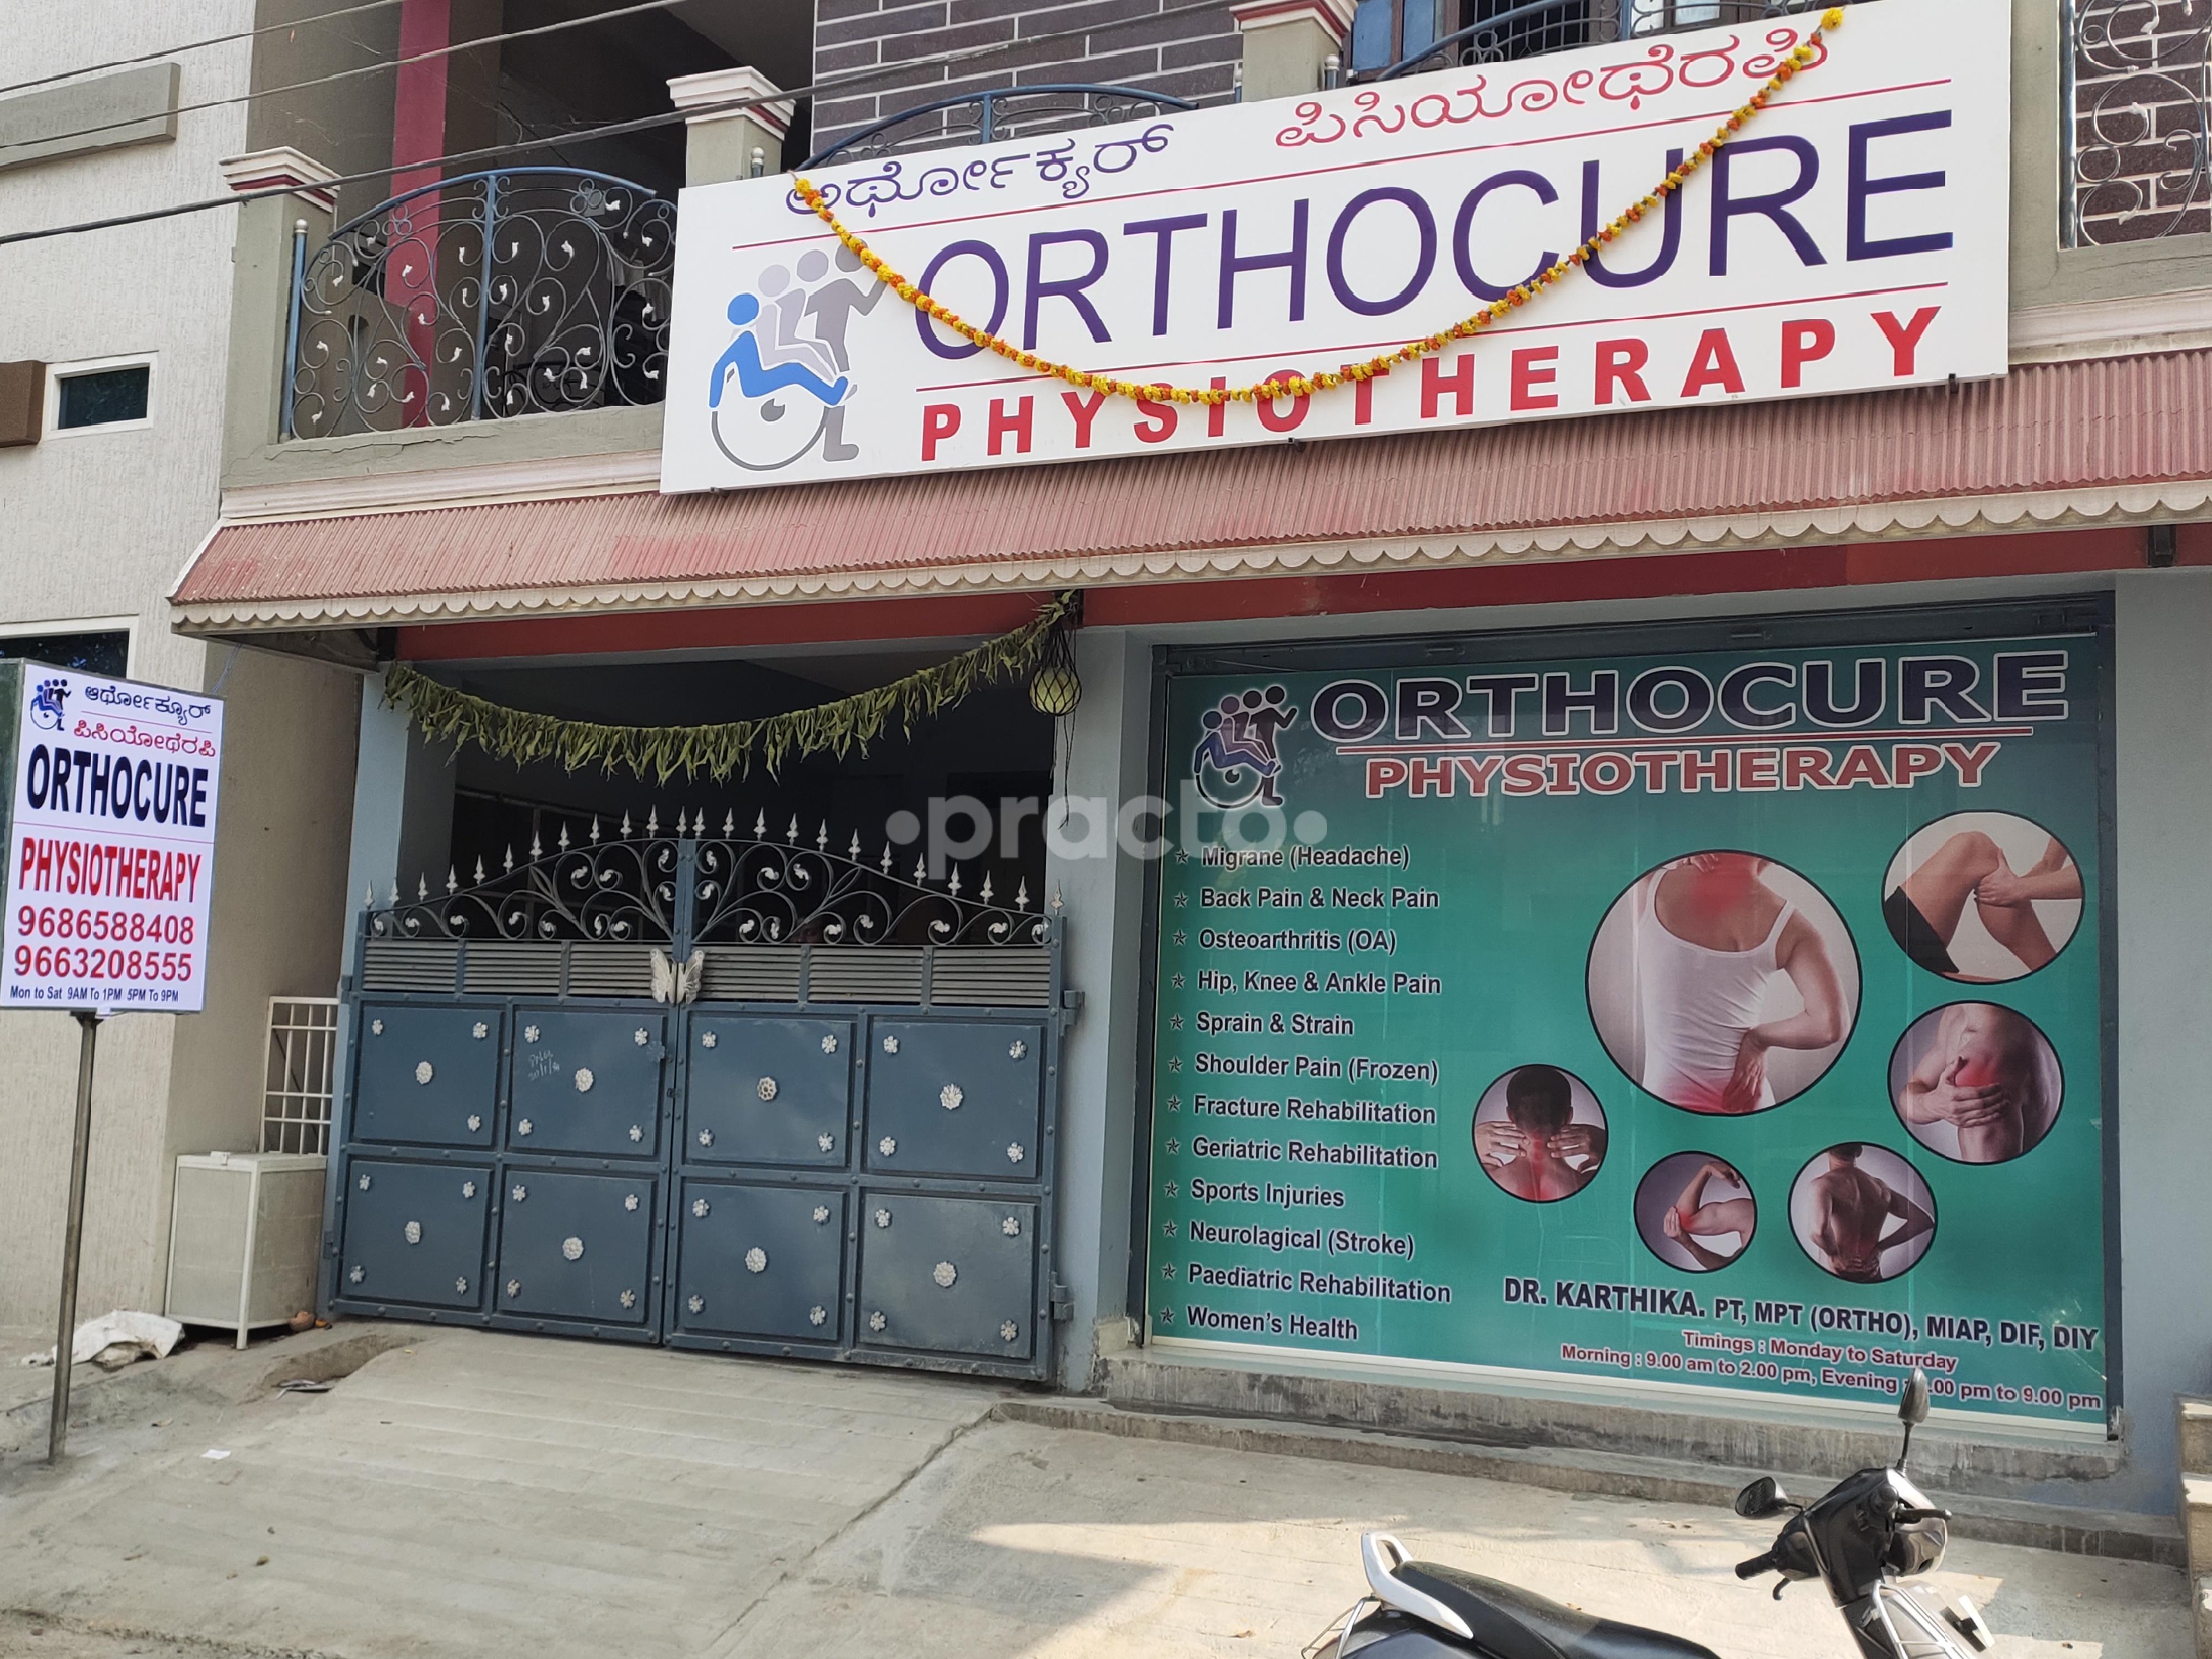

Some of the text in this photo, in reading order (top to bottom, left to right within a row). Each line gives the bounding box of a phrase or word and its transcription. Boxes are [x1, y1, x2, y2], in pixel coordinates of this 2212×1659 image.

[915, 110, 1953, 359] ORTHOCURE
[921, 305, 1942, 461] PHYSIOTHERAPY
[1310, 651, 2069, 742] ORTHOCURE
[27, 743, 208, 828] ORTHOCURE
[1364, 742, 2002, 800] PHYSIOTHERAPY
[18, 837, 201, 904] PHYSIOTHERAPY
[1202, 846, 1410, 870] Migrane (Headache)
[1201, 888, 1439, 908] Back Pain & Neck Pain
[18, 905, 194, 945] 9686588408
[1199, 930, 1396, 955] Osteoarthritis (OA)
[14, 945, 192, 982] 9663208555
[10, 985, 178, 1002] Mon to Sat 9AM To 1PM 5PM To 9PM
[1198, 971, 1441, 994] Hip, Knee & Ankle Pain
[1197, 1012, 1354, 1035] Sprain & Strain
[1196, 1053, 1438, 1086] Shoulder Pain (Frozen)
[1194, 1095, 1436, 1124] Fracture Rehabilitation
[1193, 1137, 1437, 1168] Geriatric Rehabilitation
[1191, 1179, 1344, 1209] Sports Injuries
[1190, 1221, 1414, 1260] Neurolagical (Stroke)
[1189, 1264, 1451, 1302] Paediatric Rehabilitation
[1290, 1314, 1358, 1339] Health
[1505, 1278, 2099, 1350] DR. KARTHIKA. PT, MPT (ORTHO), MIAP, DIF, DIY
[1683, 1331, 1753, 1354] Timings
[1770, 1339, 1841, 1362] Monday
[1848, 1347, 1866, 1361] to
[1872, 1349, 1957, 1373] Saturday
[1562, 1345, 1630, 1366] Morning
[1646, 1354, 1681, 1369] 9.00
[1687, 1359, 1713, 1373] am
[1719, 1359, 1735, 1374] to
[1741, 1362, 1777, 1378] 2.00
[1782, 1367, 1815, 1383] pm,
[1823, 1369, 1897, 1394] Evening
[1961, 1385, 1990, 1400] pm
[1997, 1385, 2014, 1400] to
[2023, 1388, 2062, 1404] 9.00
[2069, 1394, 2101, 1410] pm
